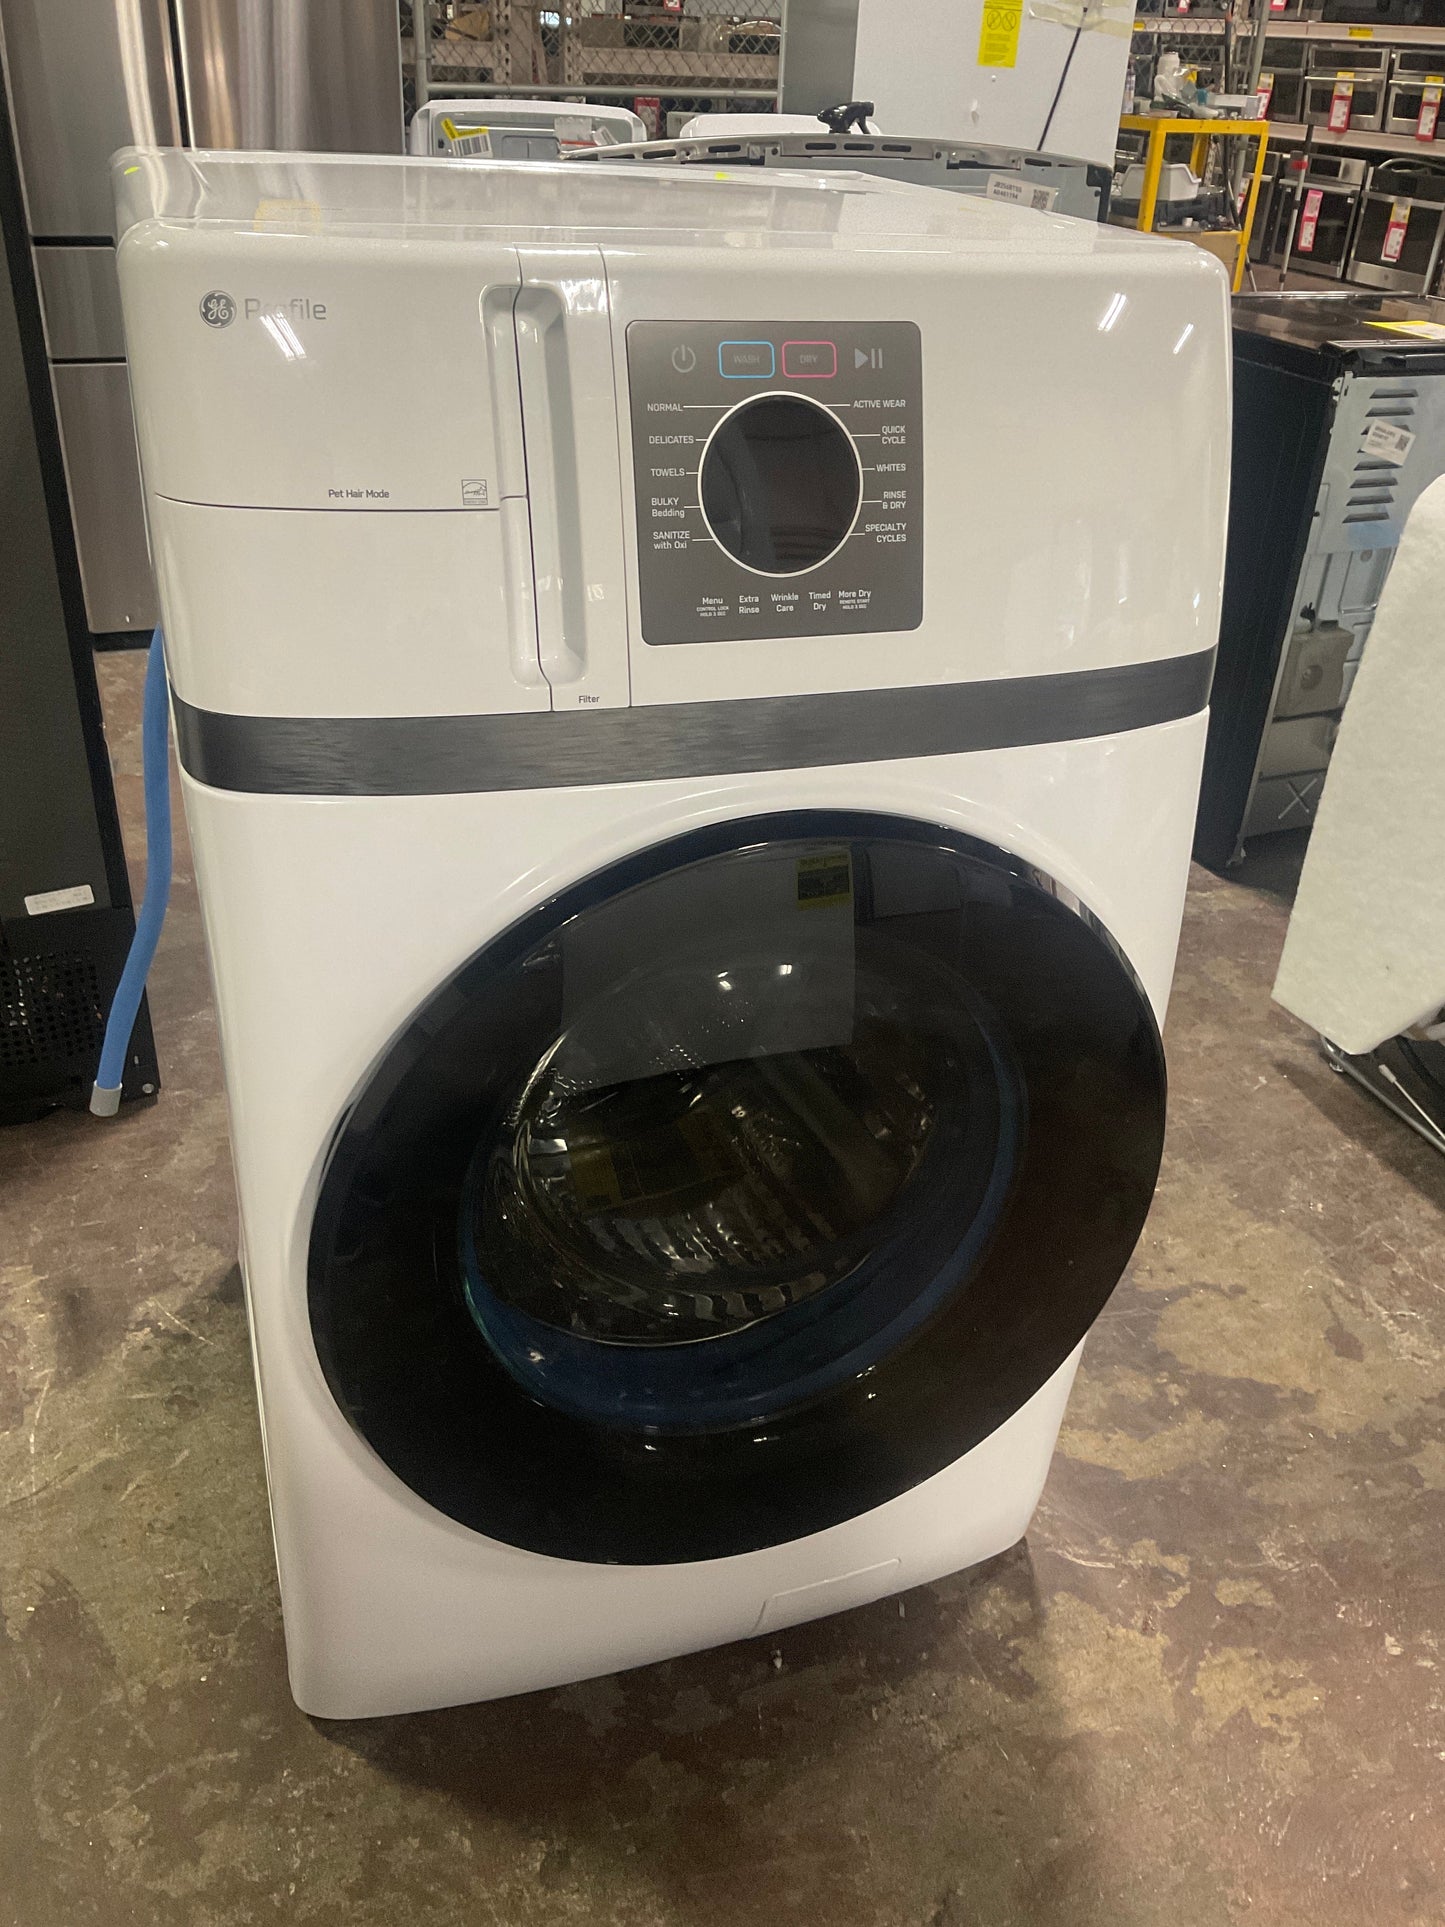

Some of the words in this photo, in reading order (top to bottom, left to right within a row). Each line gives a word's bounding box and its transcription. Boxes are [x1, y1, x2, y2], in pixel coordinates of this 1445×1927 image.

[734, 354, 760, 364] WASH
[800, 355, 818, 364] DRY
[647, 403, 683, 412] NORMAL
[853, 400, 880, 408] ACTIVE
[883, 399, 906, 408] WEAR
[881, 425, 906, 435] QUICK
[649, 436, 694, 444] DELICATES
[881, 436, 906, 444] CYCLE
[651, 468, 685, 476] TOWELS
[876, 463, 906, 472] WHITES
[328, 489, 344, 498] Pet
[346, 489, 364, 498] Hair
[366, 489, 390, 498] Mode
[883, 491, 907, 499] RINSE
[651, 497, 679, 506] BULKY
[882, 501, 888, 510] &
[889, 501, 907, 510] DRY
[651, 508, 685, 518] Bedding
[865, 523, 907, 532] SPECIALTY
[653, 531, 690, 540] SANITIZE
[876, 534, 907, 543] CYCLES
[654, 541, 672, 549] with
[674, 540, 687, 549] Oxi
[771, 593, 799, 602] Wrinkle
[808, 591, 831, 600] Timed
[838, 590, 857, 599] More
[859, 589, 872, 599] Dry
[702, 597, 723, 605] Menu
[739, 595, 759, 603] Extra
[739, 606, 760, 614] Rinse
[776, 604, 794, 612] Care
[813, 602, 827, 612] Dry
[578, 695, 600, 703] Filter
